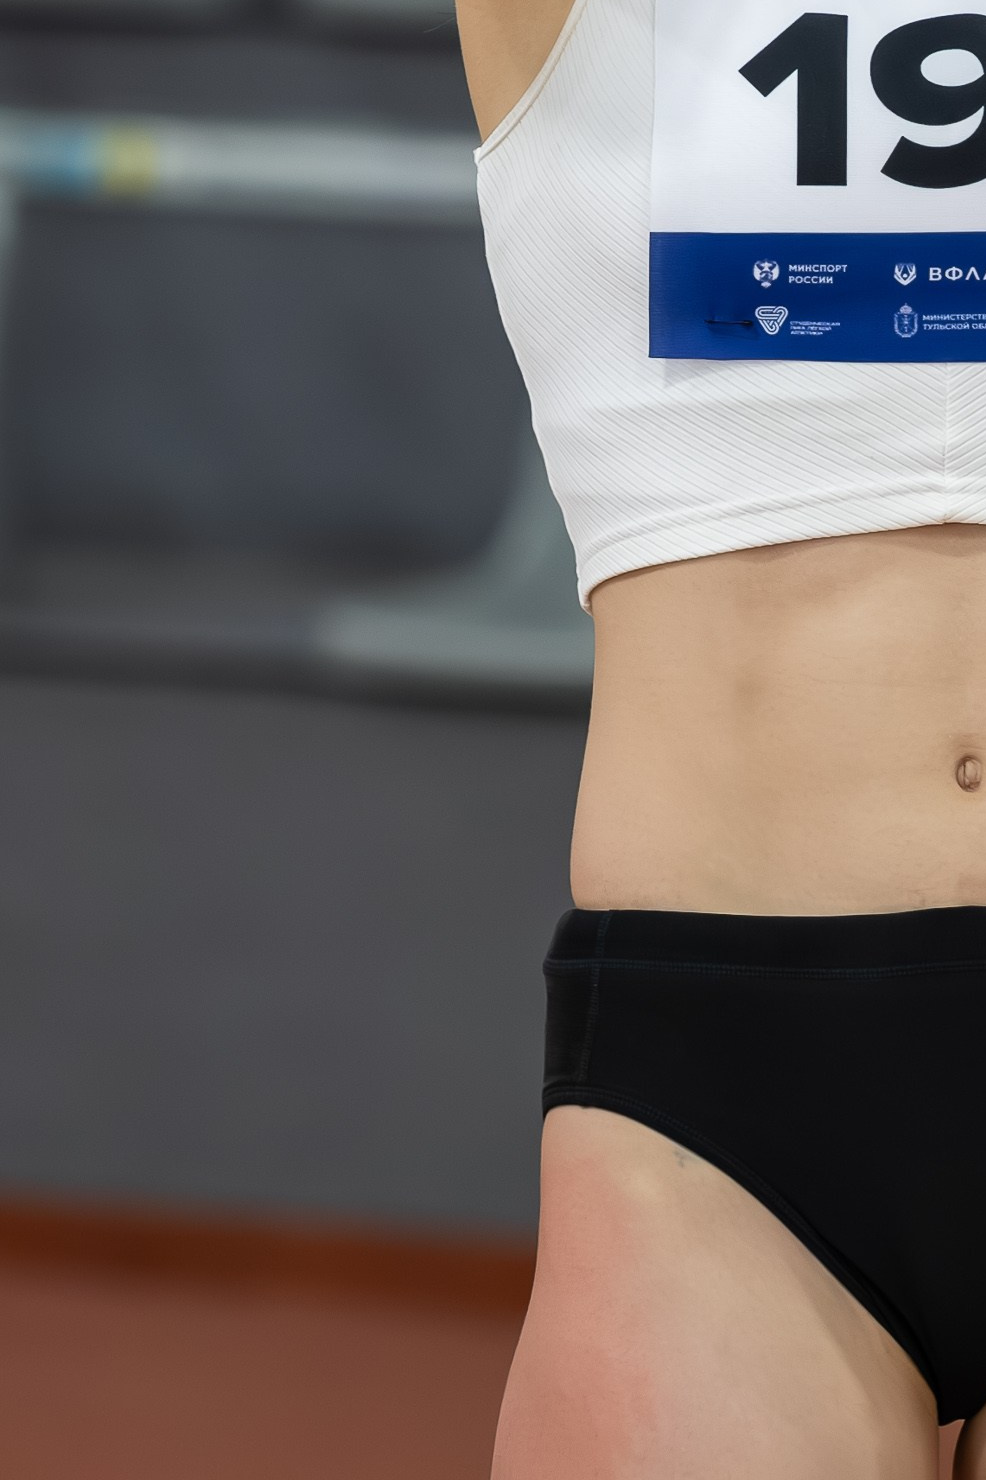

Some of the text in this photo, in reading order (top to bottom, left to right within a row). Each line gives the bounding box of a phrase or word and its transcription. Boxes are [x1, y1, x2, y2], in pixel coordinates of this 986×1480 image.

[788, 264, 848, 273] МИНСПОРТ
[788, 275, 834, 284] РОССИИ
[922, 322, 970, 330] ТУЛЬСКОЙ
